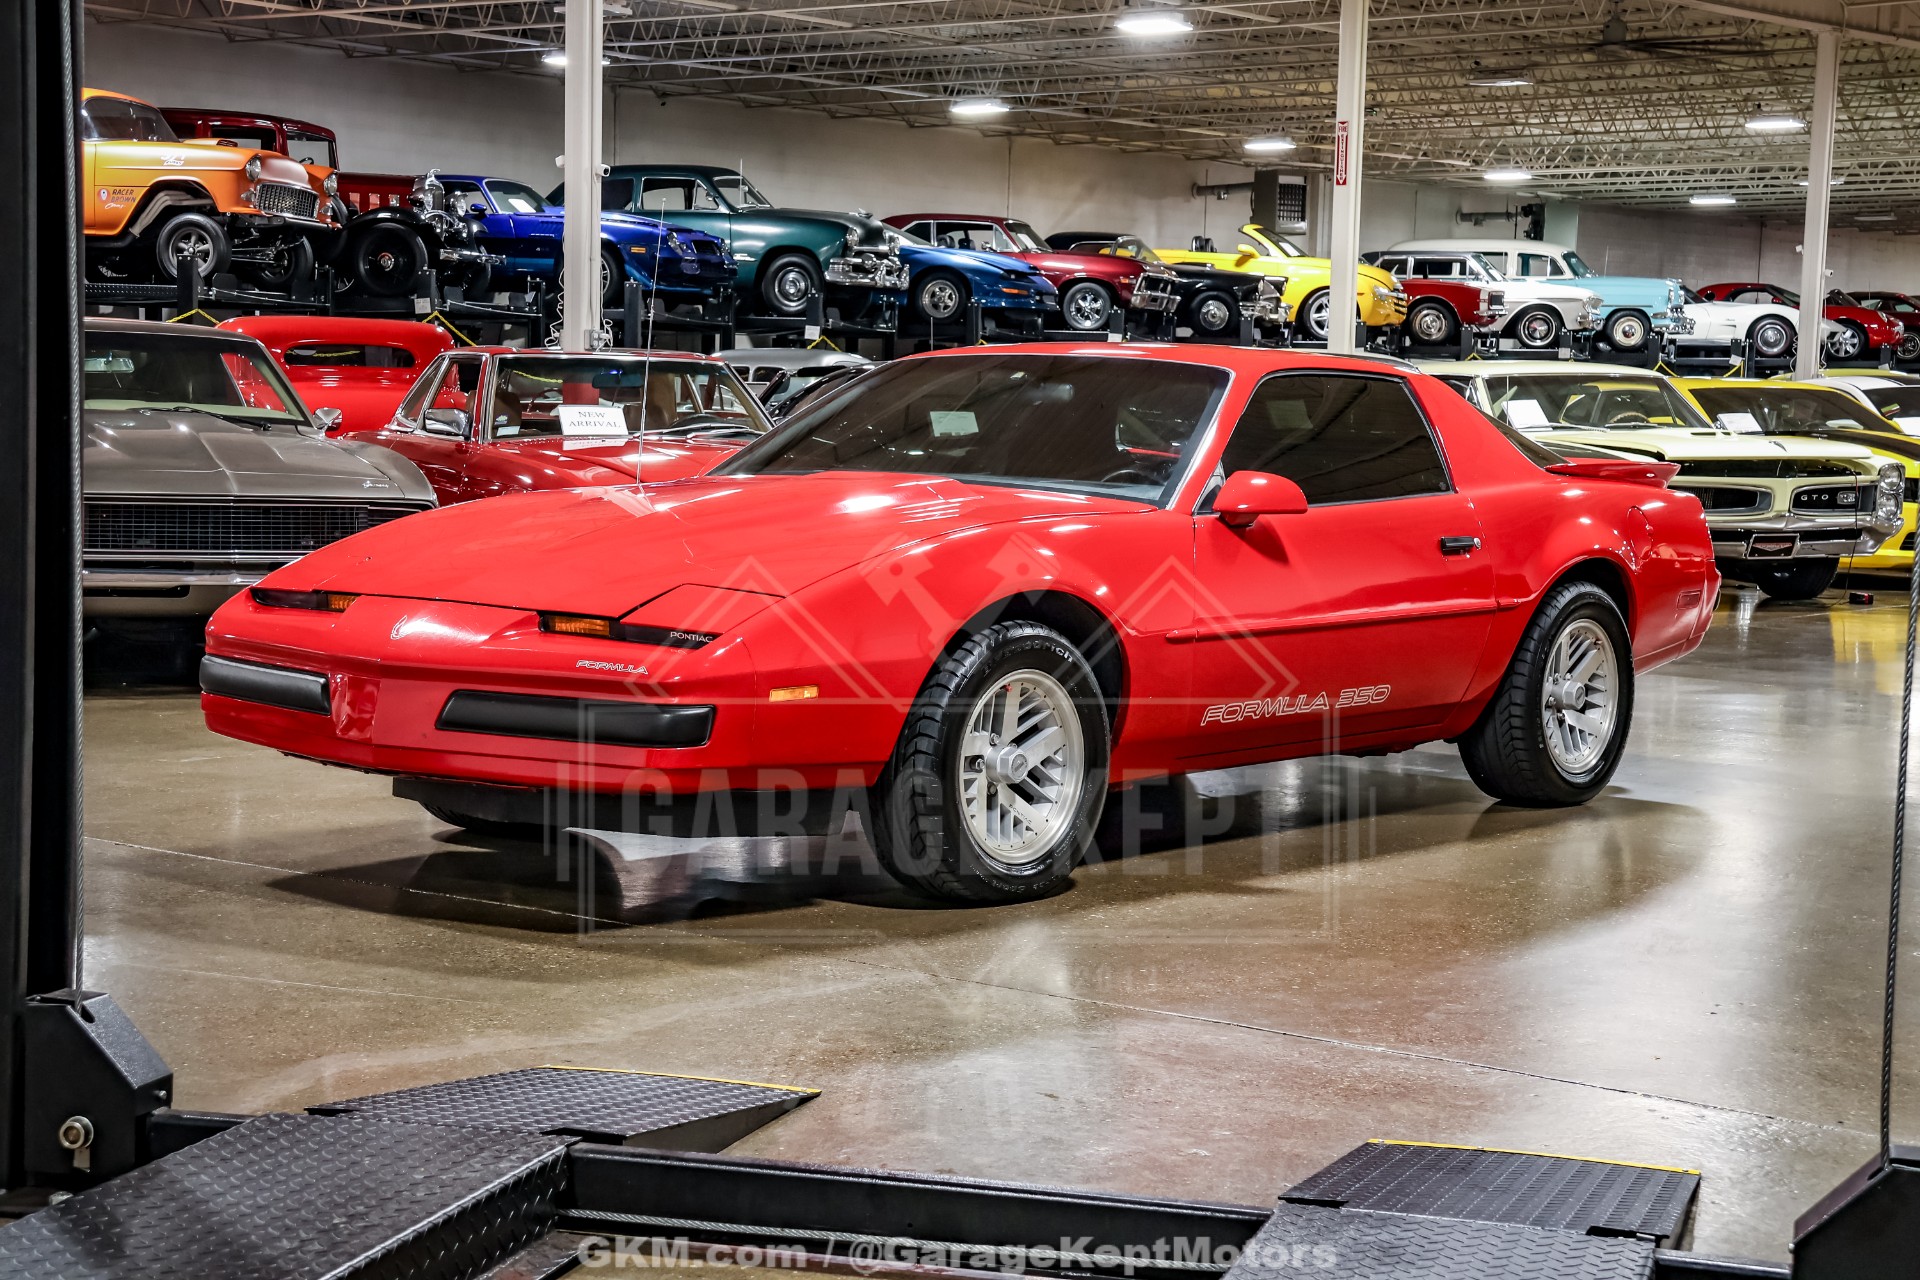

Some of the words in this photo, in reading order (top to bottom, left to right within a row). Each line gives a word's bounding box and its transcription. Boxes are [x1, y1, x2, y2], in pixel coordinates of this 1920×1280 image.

[112, 188, 135, 196] RACER
[111, 195, 137, 203] BROWN
[568, 420, 621, 428] ARRIVAL
[1800, 493, 1829, 501] GTO
[670, 631, 713, 643] PONTIAC
[576, 659, 649, 675] FORMULA
[1200, 691, 1330, 726] FORMULA
[1335, 684, 1392, 709] 350
[1008, 803, 1033, 825] PONTIAC
